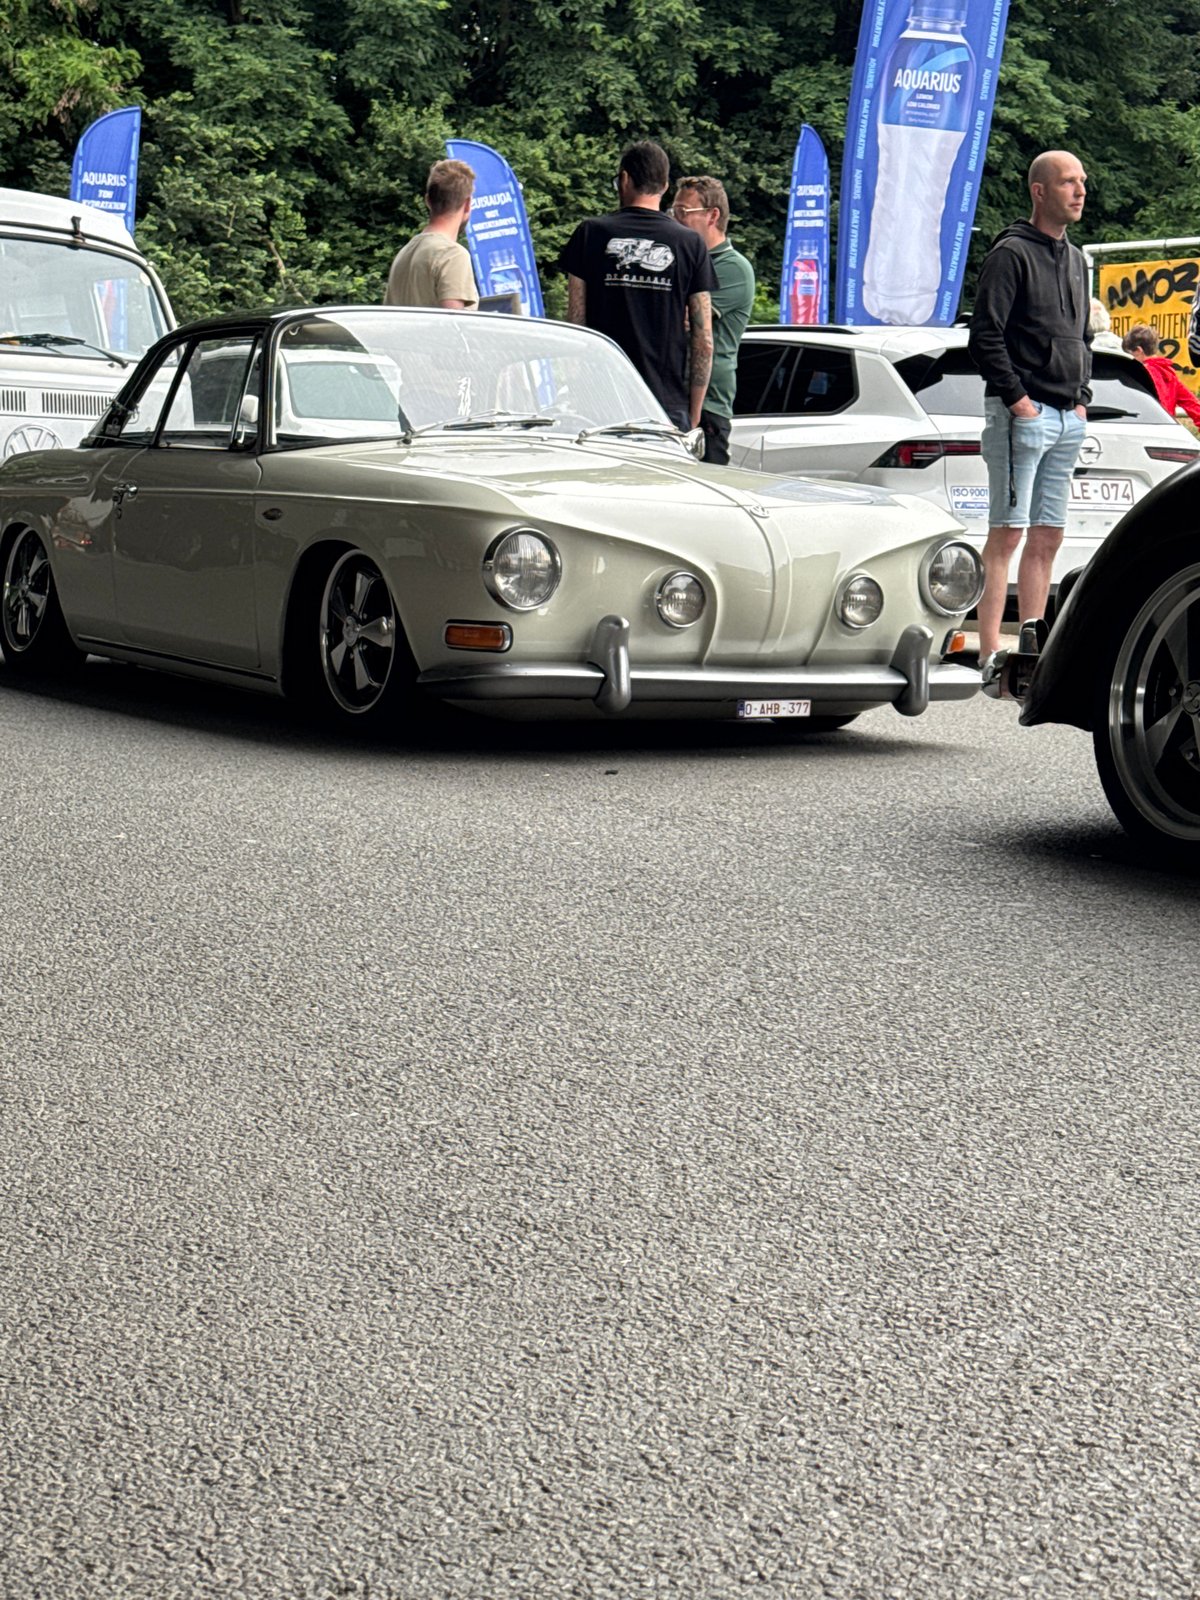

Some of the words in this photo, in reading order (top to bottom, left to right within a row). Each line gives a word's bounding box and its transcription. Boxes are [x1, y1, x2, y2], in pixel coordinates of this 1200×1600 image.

[993, 0, 1003, 16] AILY
[986, 16, 1000, 59] HYDRATION
[865, 57, 877, 89] AQUARIUS
[893, 68, 962, 93] AQUARIUS
[979, 68, 992, 101] AQUARIUS
[974, 110, 986, 130] DAILY
[967, 130, 981, 172] HYDRATION
[82, 171, 127, 187] AQUARIUS
[960, 181, 973, 212] AQUARIUS
[947, 241, 962, 282] HYDRATION
[953, 488, 969, 497] ISO
[970, 488, 989, 497] 9001
